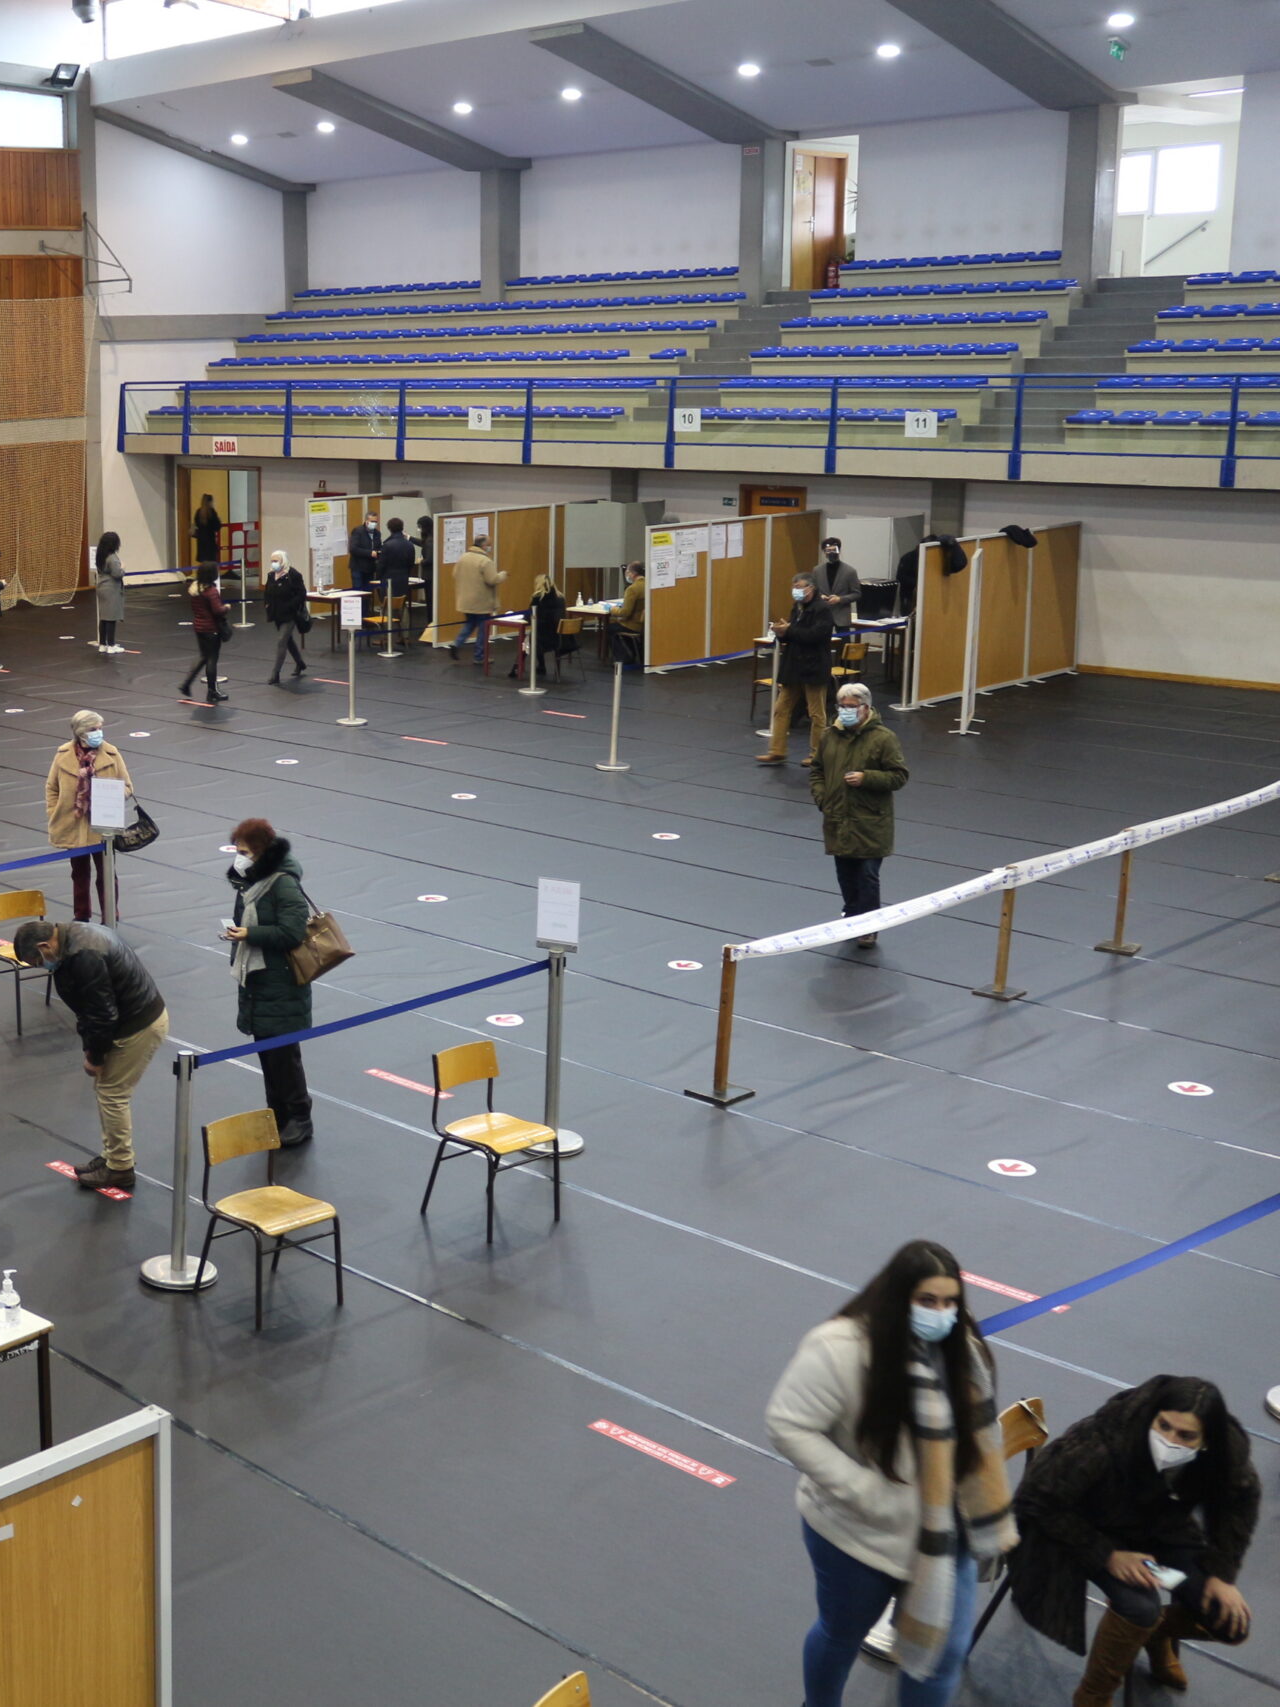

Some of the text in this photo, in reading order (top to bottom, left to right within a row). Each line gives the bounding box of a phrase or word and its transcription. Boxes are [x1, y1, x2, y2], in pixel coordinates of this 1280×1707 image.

[681, 413, 694, 425] 10
[914, 417, 927, 429] 11
[214, 439, 236, 453] SAÍDA
